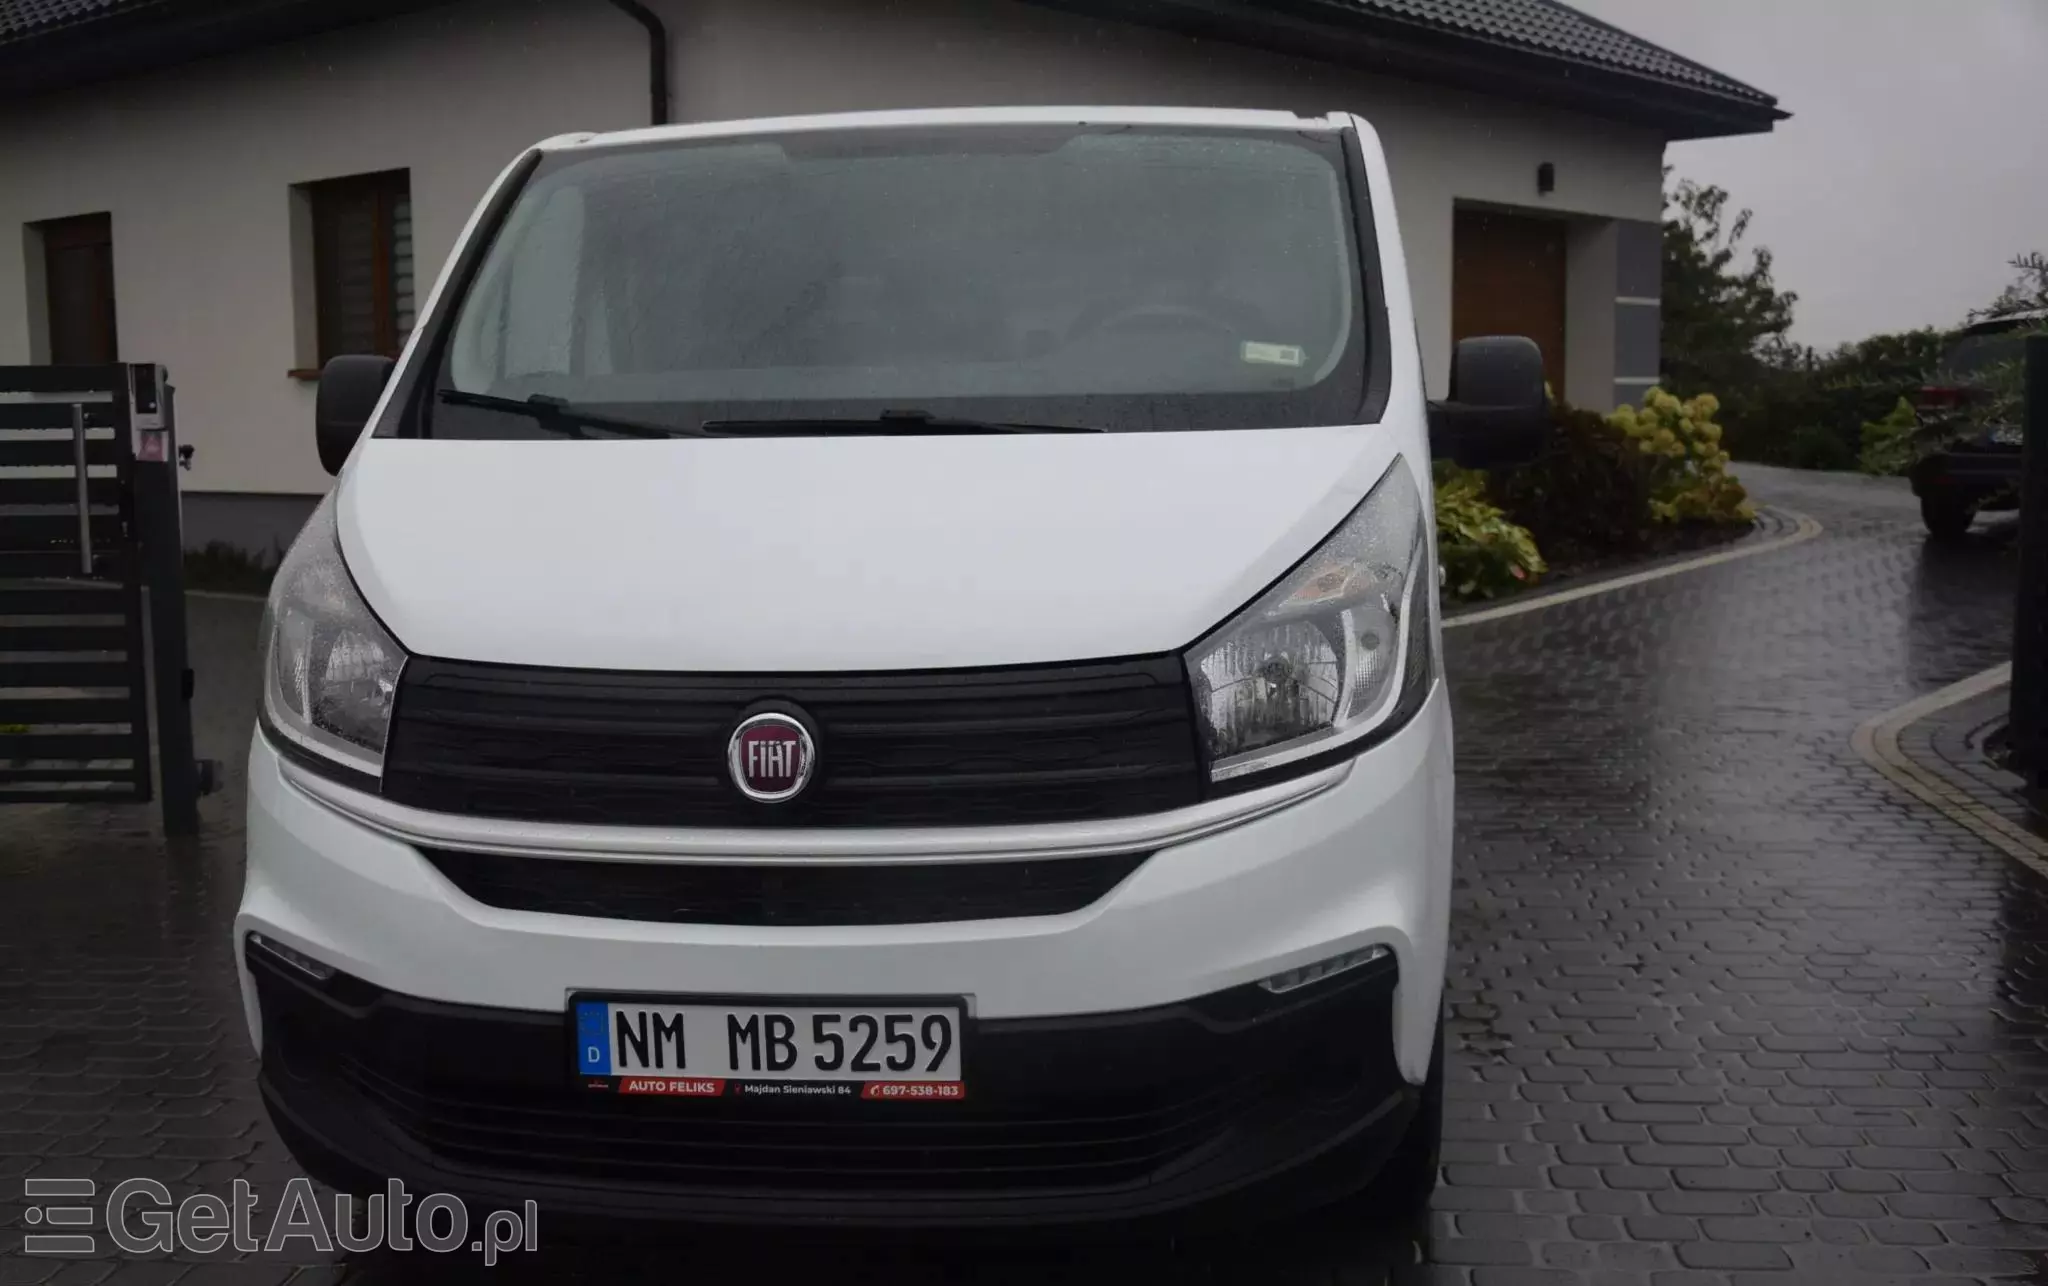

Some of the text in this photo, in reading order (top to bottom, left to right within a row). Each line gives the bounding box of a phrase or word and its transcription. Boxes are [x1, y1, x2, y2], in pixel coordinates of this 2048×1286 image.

[748, 740, 796, 778] FIAT
[616, 1010, 952, 1073] NM MB 5259
[587, 1046, 600, 1063] D
[628, 1080, 715, 1094] AUTO FELIKS
[744, 1084, 852, 1095] Majdan Sieniawski 84
[882, 1085, 959, 1097] 697-538-183
